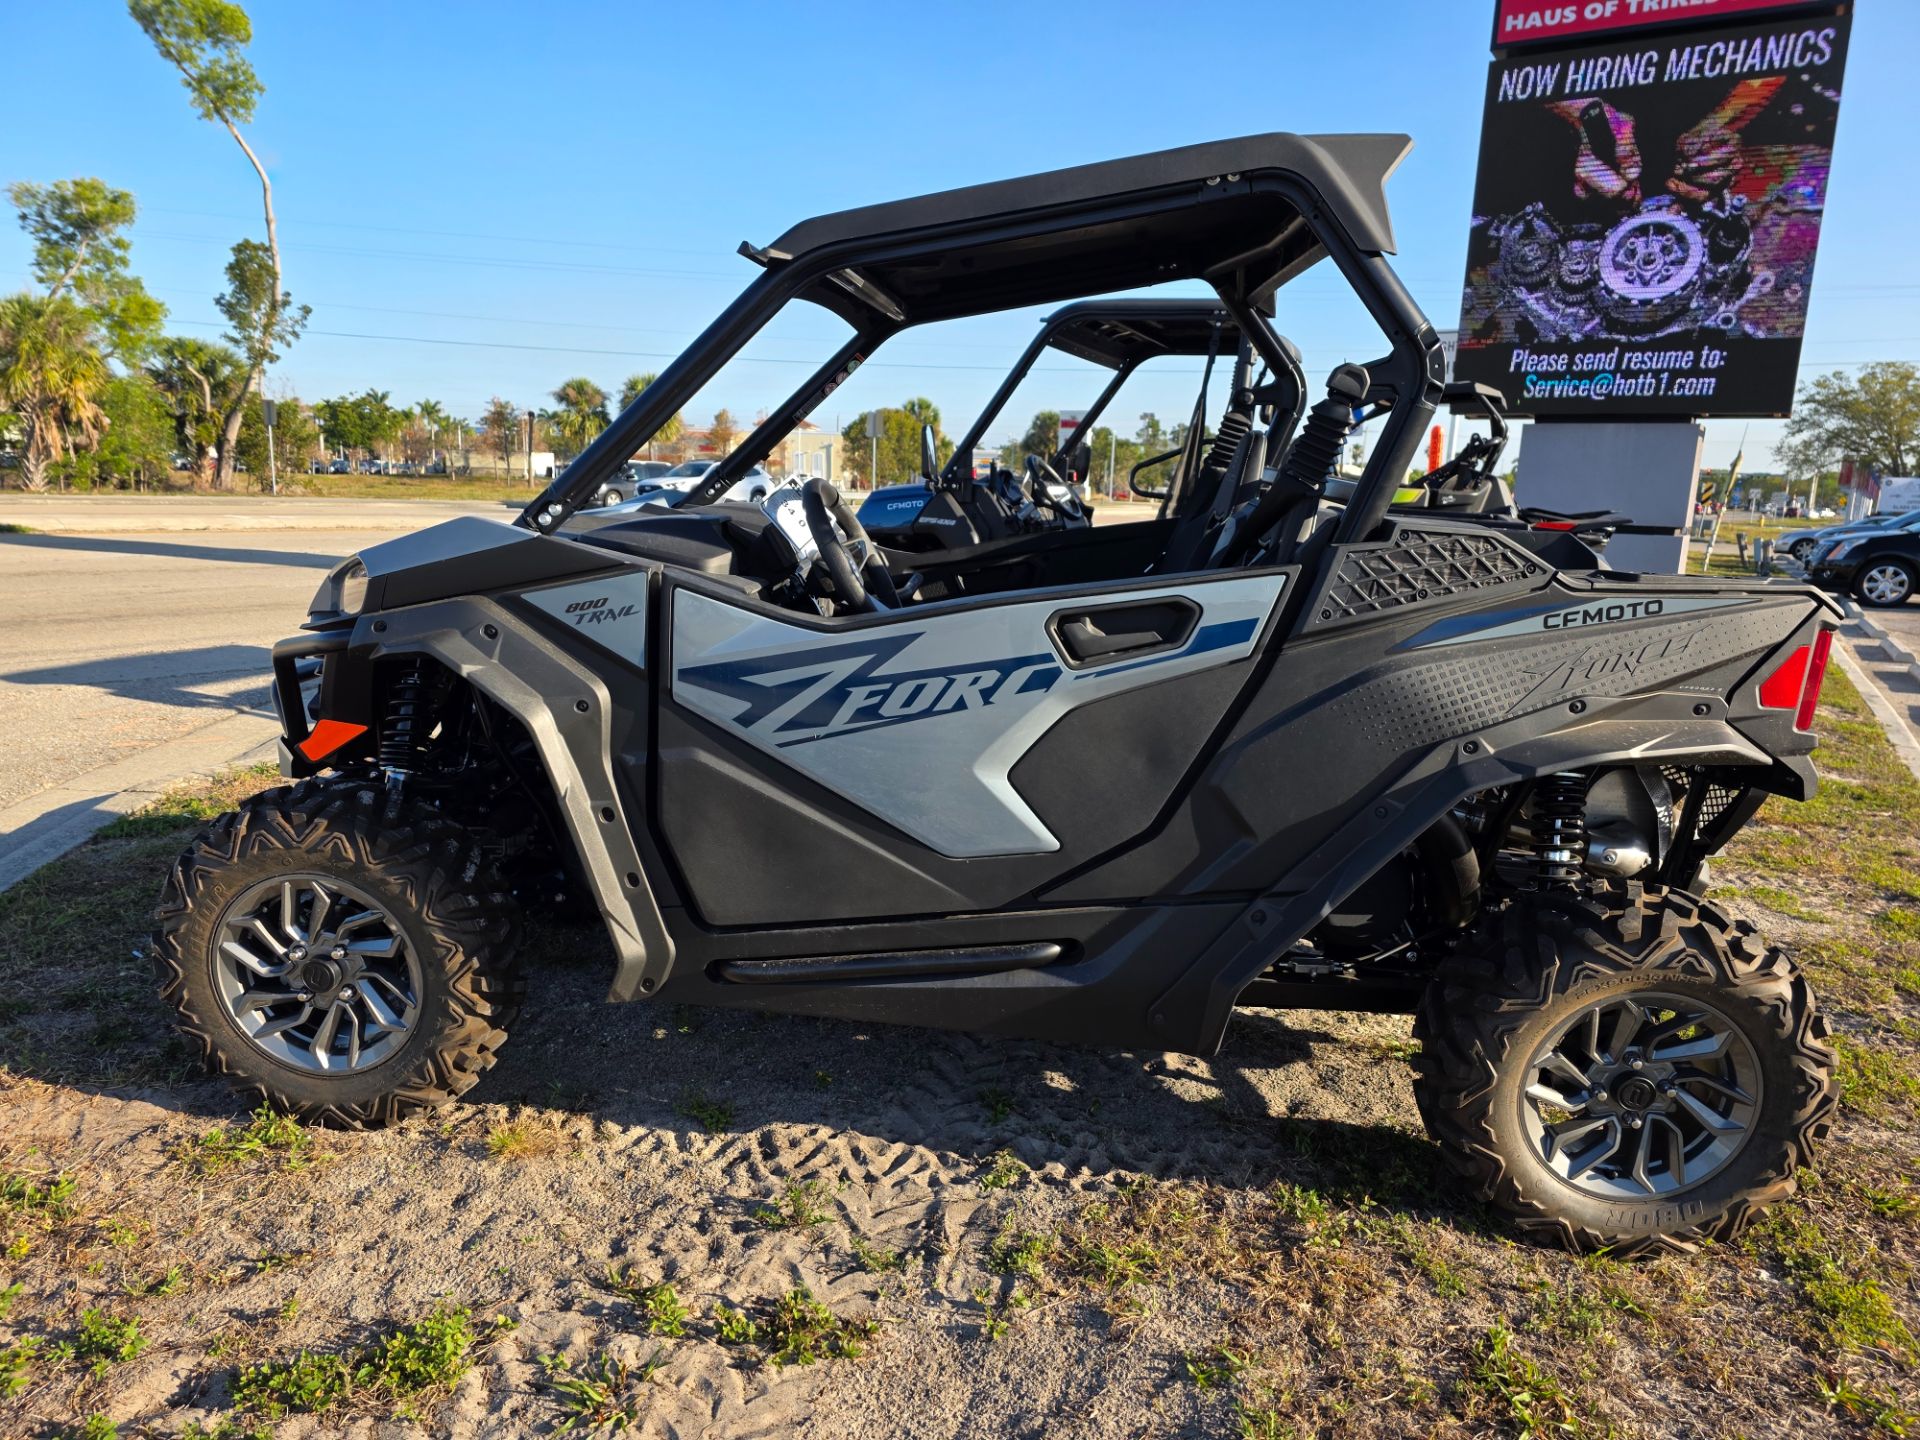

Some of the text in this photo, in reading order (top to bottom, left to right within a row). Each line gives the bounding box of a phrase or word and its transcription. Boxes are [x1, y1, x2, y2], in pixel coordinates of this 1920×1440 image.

[1504, 5, 1577, 32] HAUS
[1583, 1, 1619, 20] OF
[1498, 27, 1837, 102] NOW HIRING MECHANICS
[1509, 345, 1728, 373] Please send resume to:
[1523, 372, 1717, 400] Service@hotb1.com
[887, 500, 924, 510] CFMOTO
[565, 597, 609, 613] 800
[574, 604, 641, 625] TRAIL
[1543, 599, 1663, 630] CFMOTO
